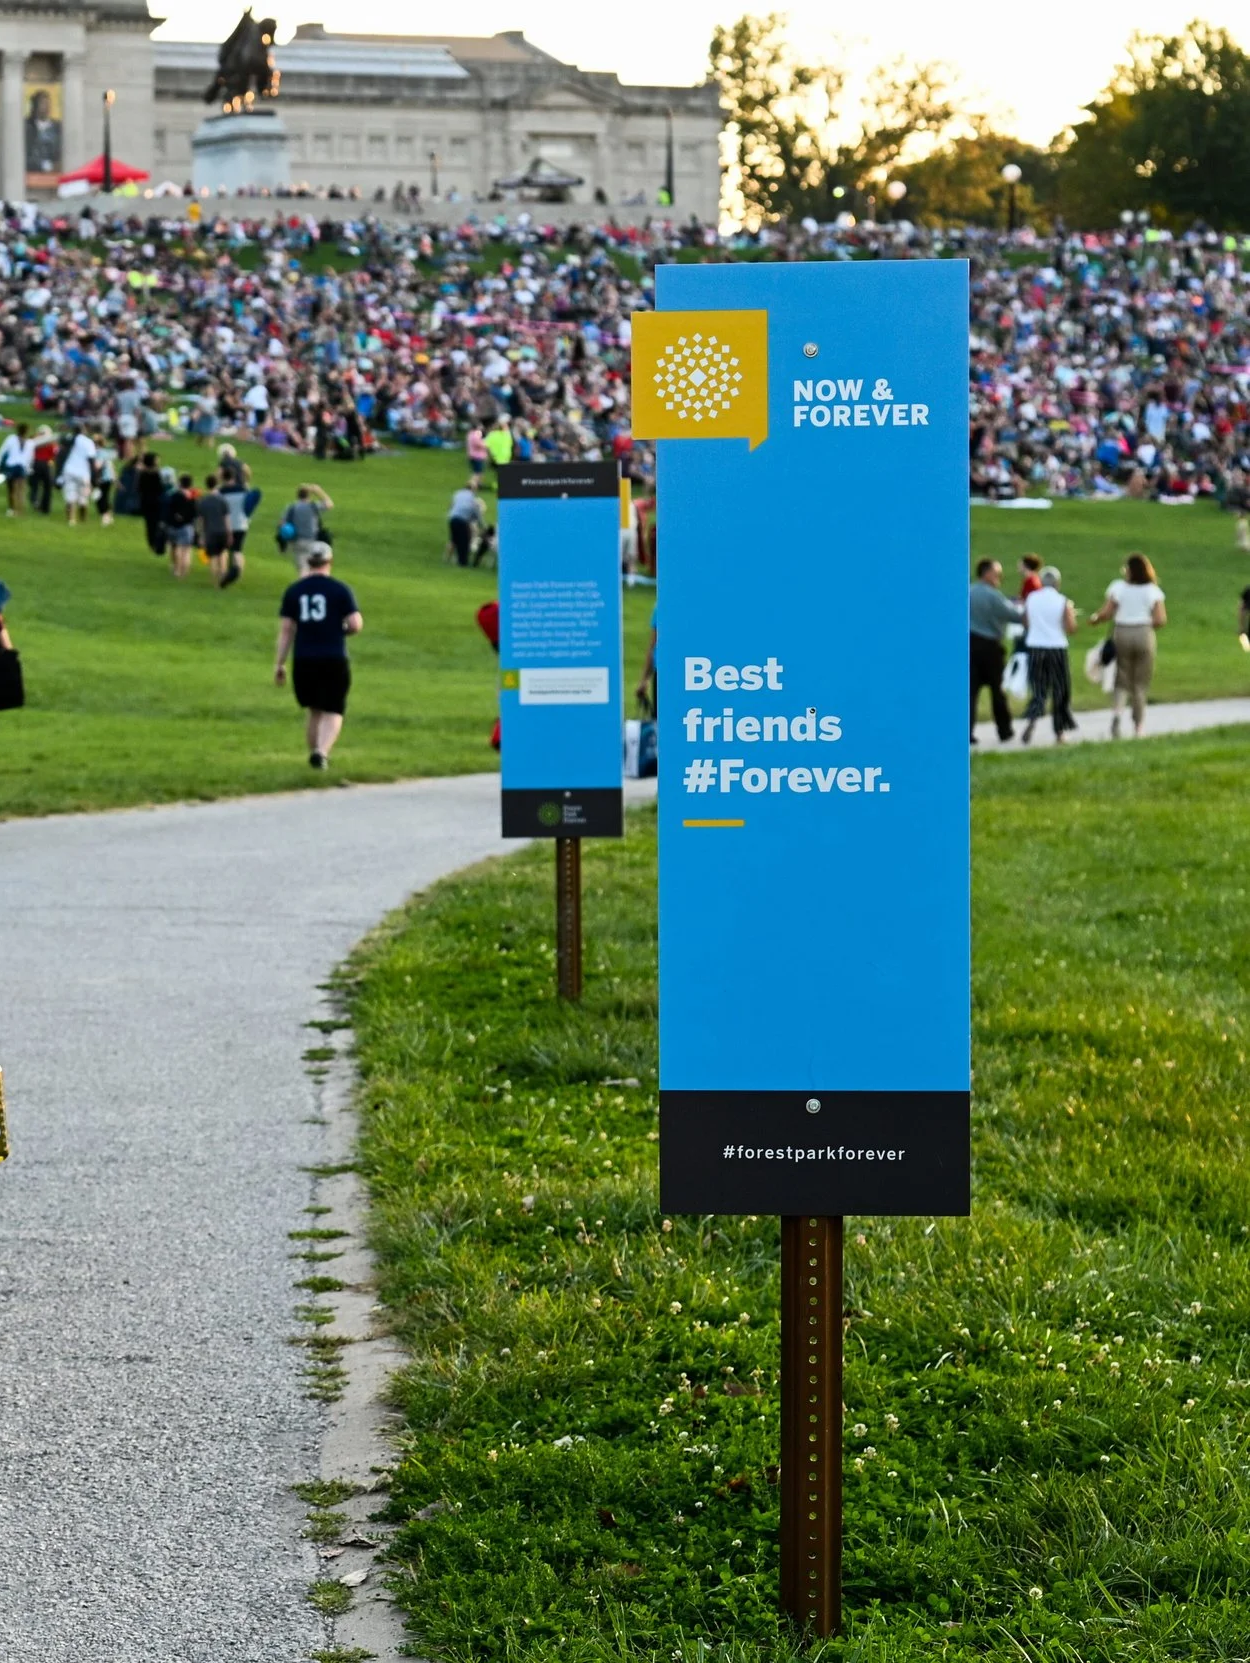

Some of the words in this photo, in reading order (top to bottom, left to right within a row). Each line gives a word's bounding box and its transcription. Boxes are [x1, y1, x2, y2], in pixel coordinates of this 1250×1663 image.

[793, 379, 864, 402] NOW
[871, 378, 894, 401] &
[793, 403, 929, 428] FOREVER
[299, 593, 327, 622] 13
[684, 656, 784, 691] Best
[682, 707, 842, 742] friends
[683, 758, 890, 793] #Forever.
[722, 1144, 906, 1163] #forestparkforever
